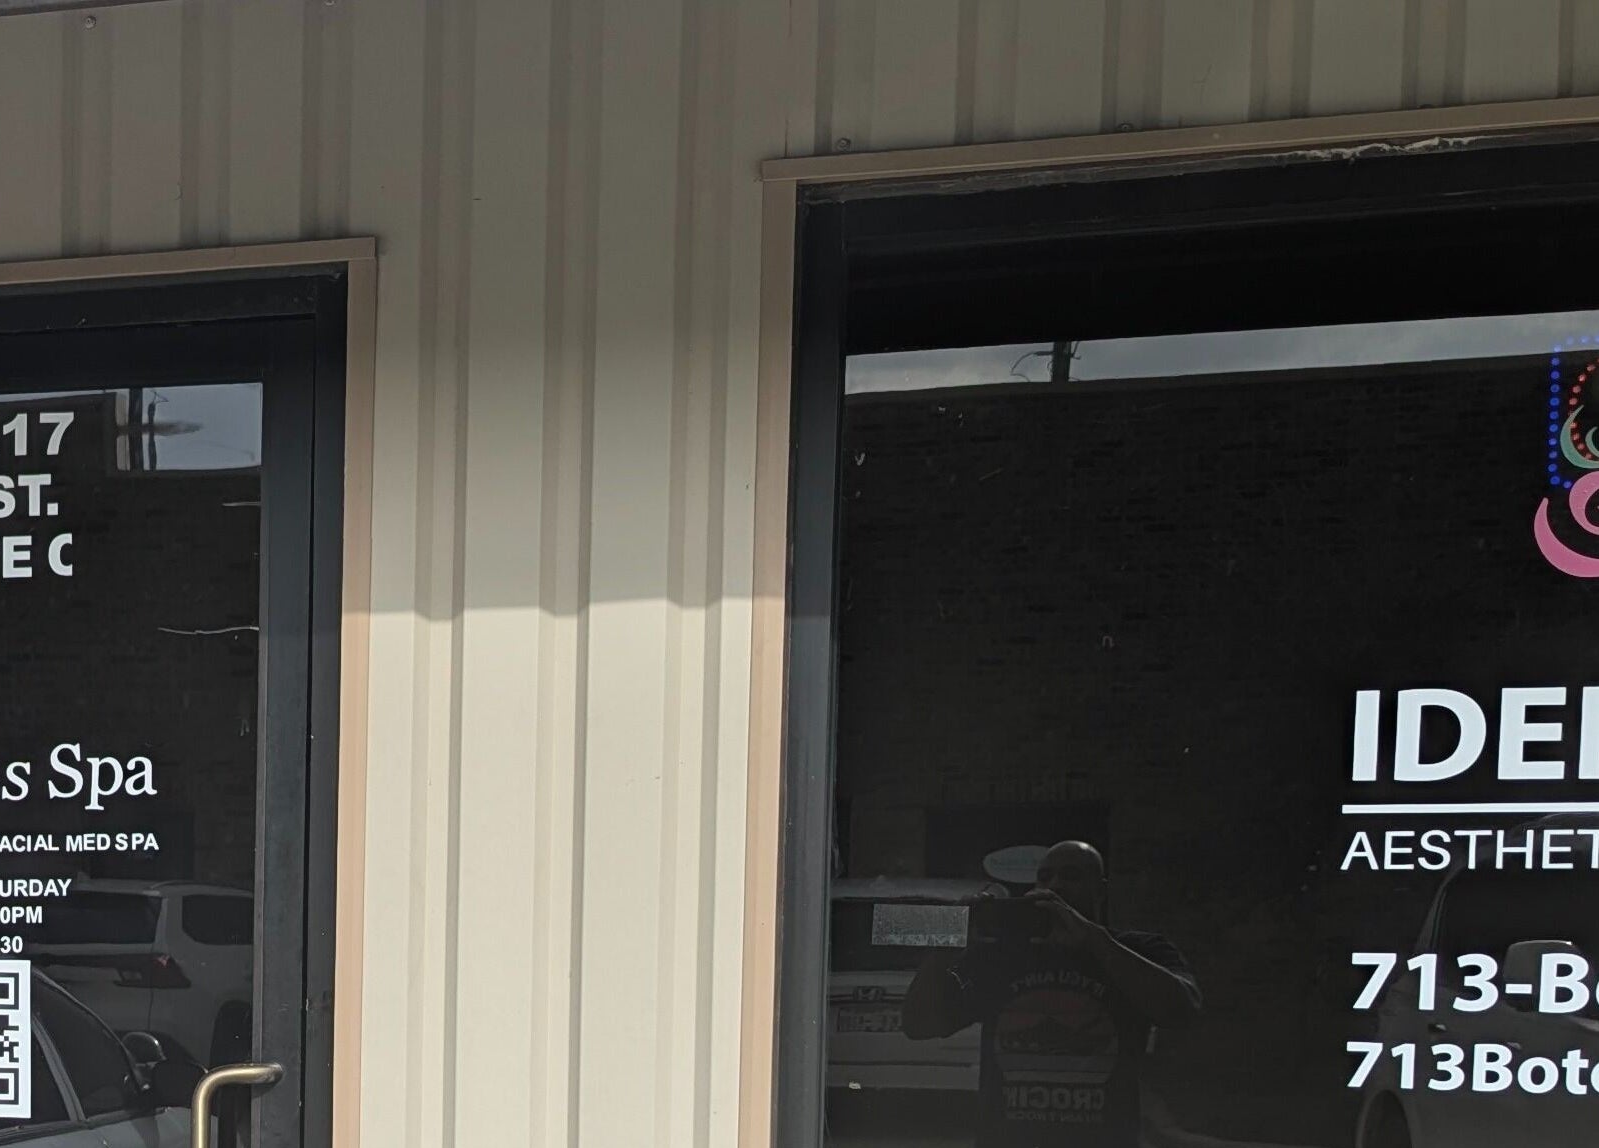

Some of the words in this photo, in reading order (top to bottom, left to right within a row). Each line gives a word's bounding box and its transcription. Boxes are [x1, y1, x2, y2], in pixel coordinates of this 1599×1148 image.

[48, 532, 73, 577] C
[47, 743, 158, 811] Spa
[65, 833, 111, 852] MED
[114, 832, 160, 851] SPA
[1351, 952, 1599, 1014] 713-B
[1345, 1040, 1599, 1095] 713Bot
